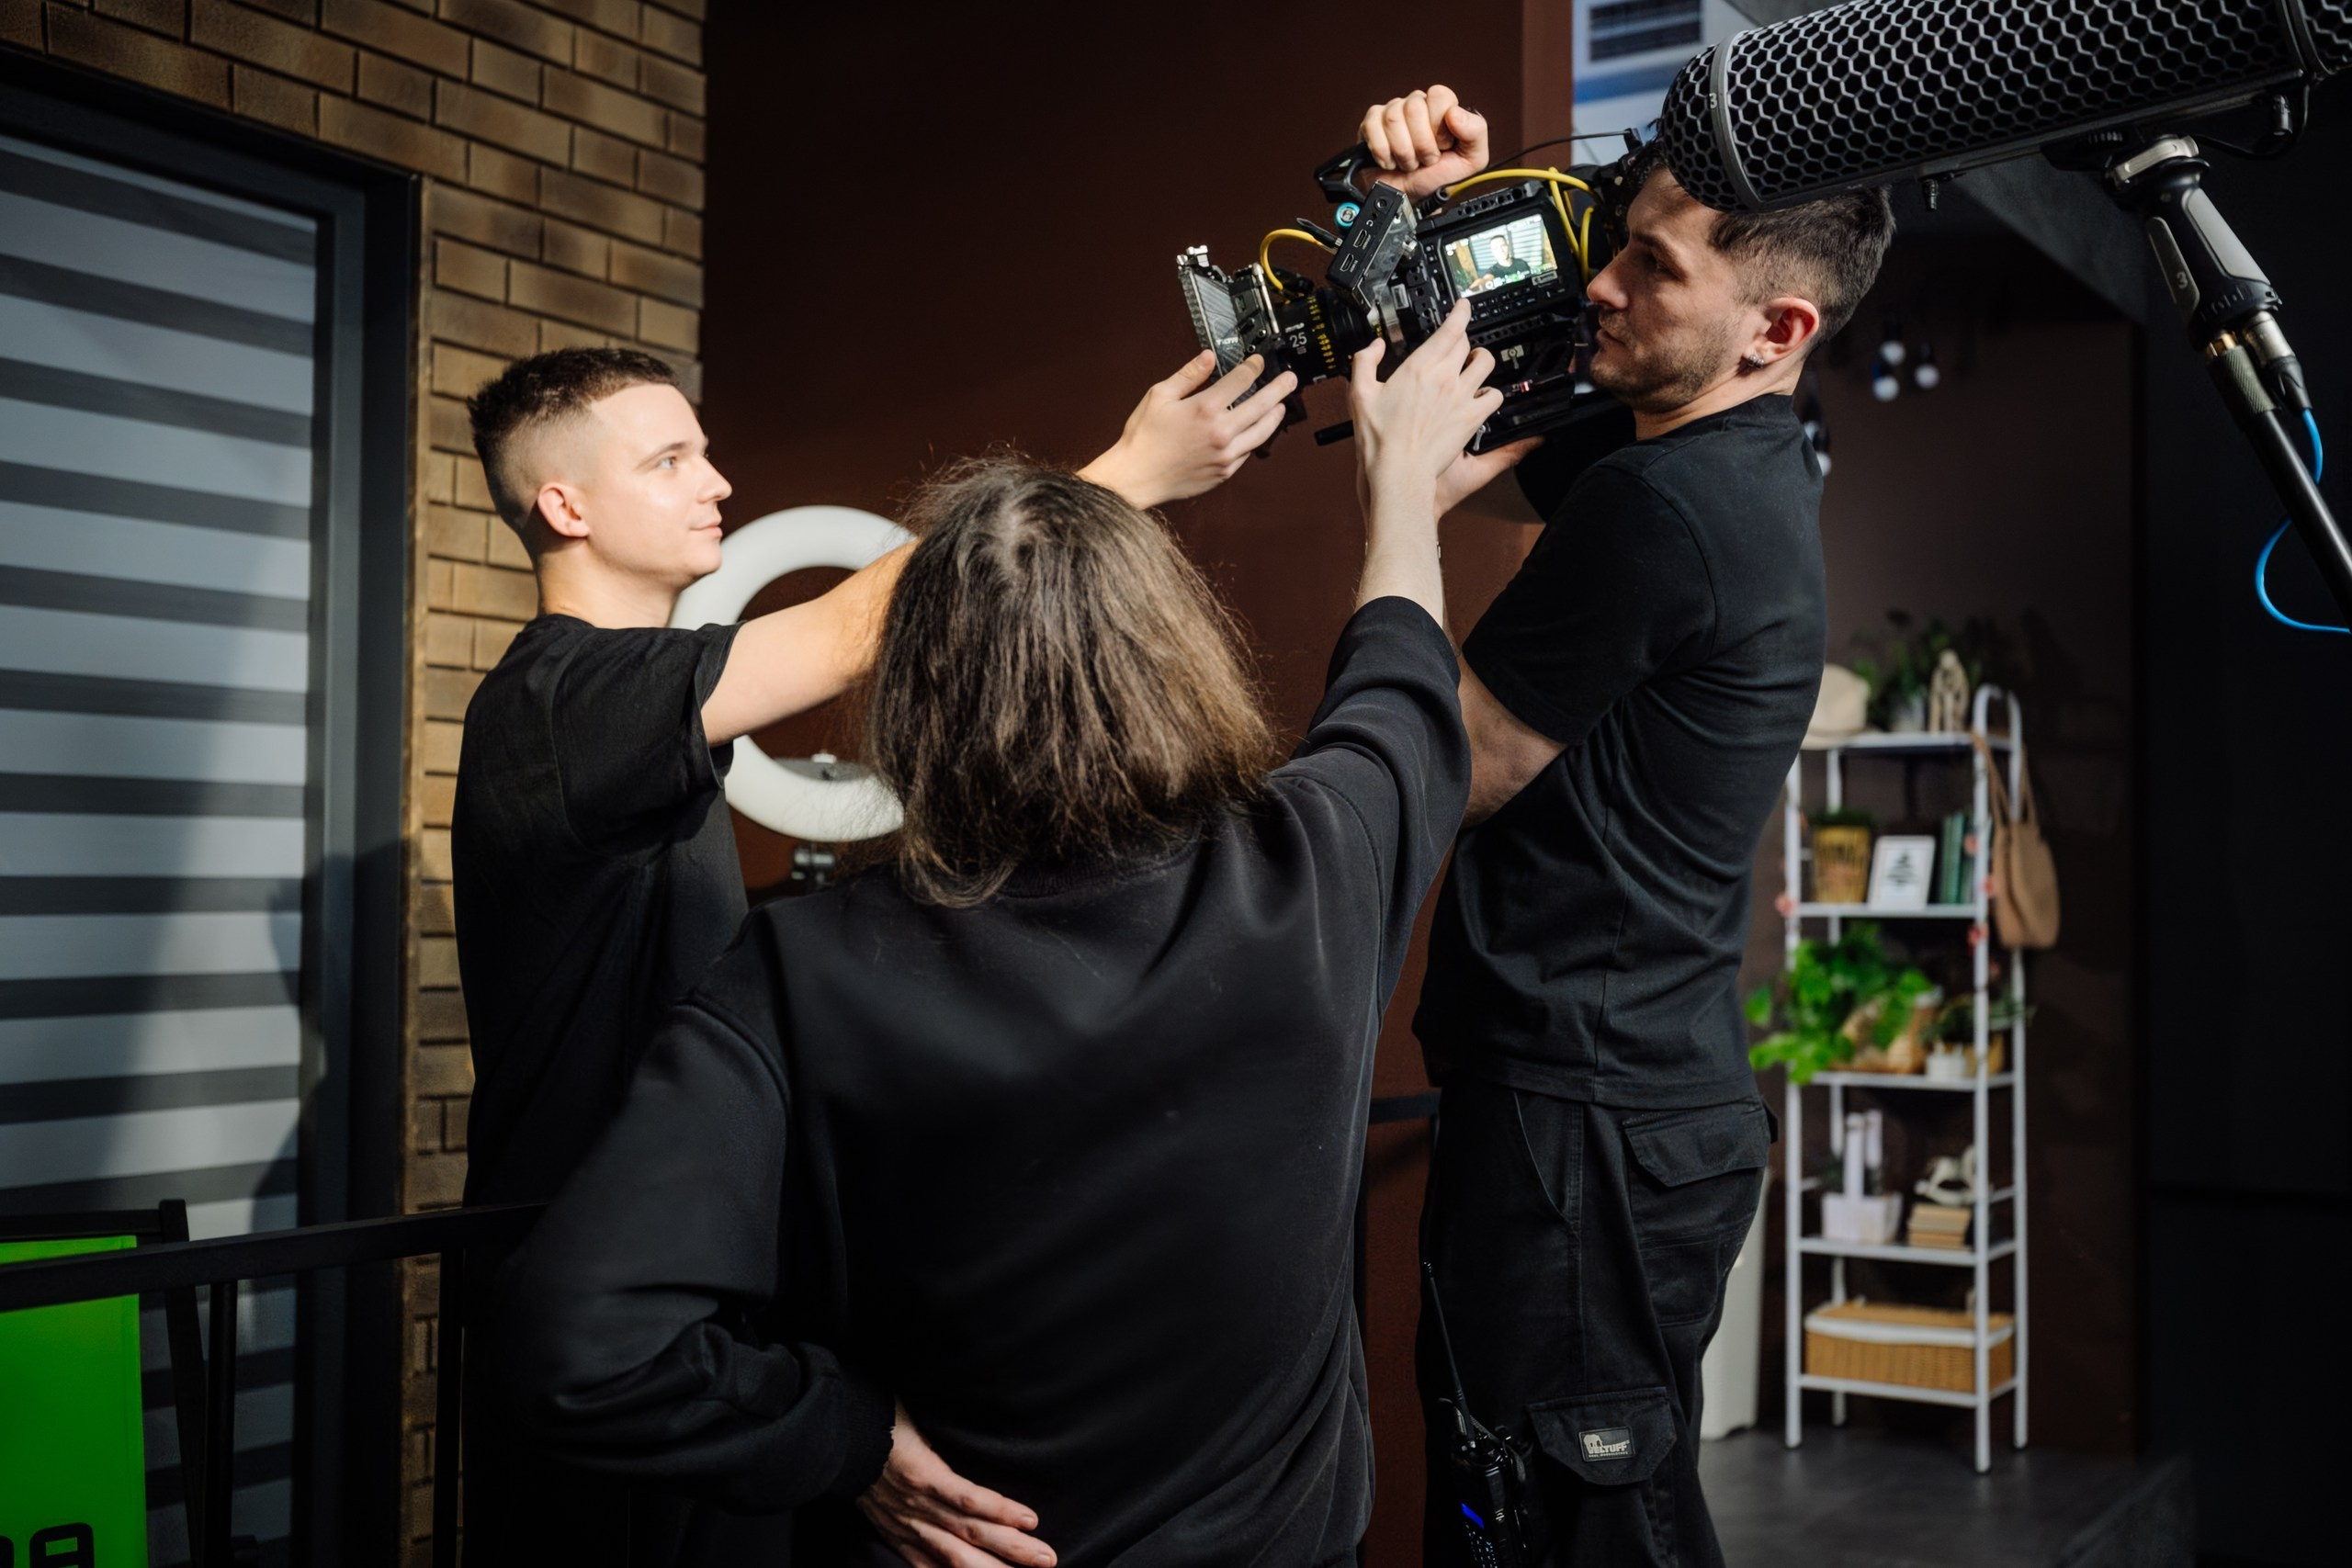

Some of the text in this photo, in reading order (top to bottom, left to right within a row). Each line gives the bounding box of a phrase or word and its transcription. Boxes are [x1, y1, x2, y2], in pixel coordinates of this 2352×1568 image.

[1709, 92, 1718, 109] 3
[2176, 271, 2188, 289] 3
[1289, 332, 1307, 348] 25
